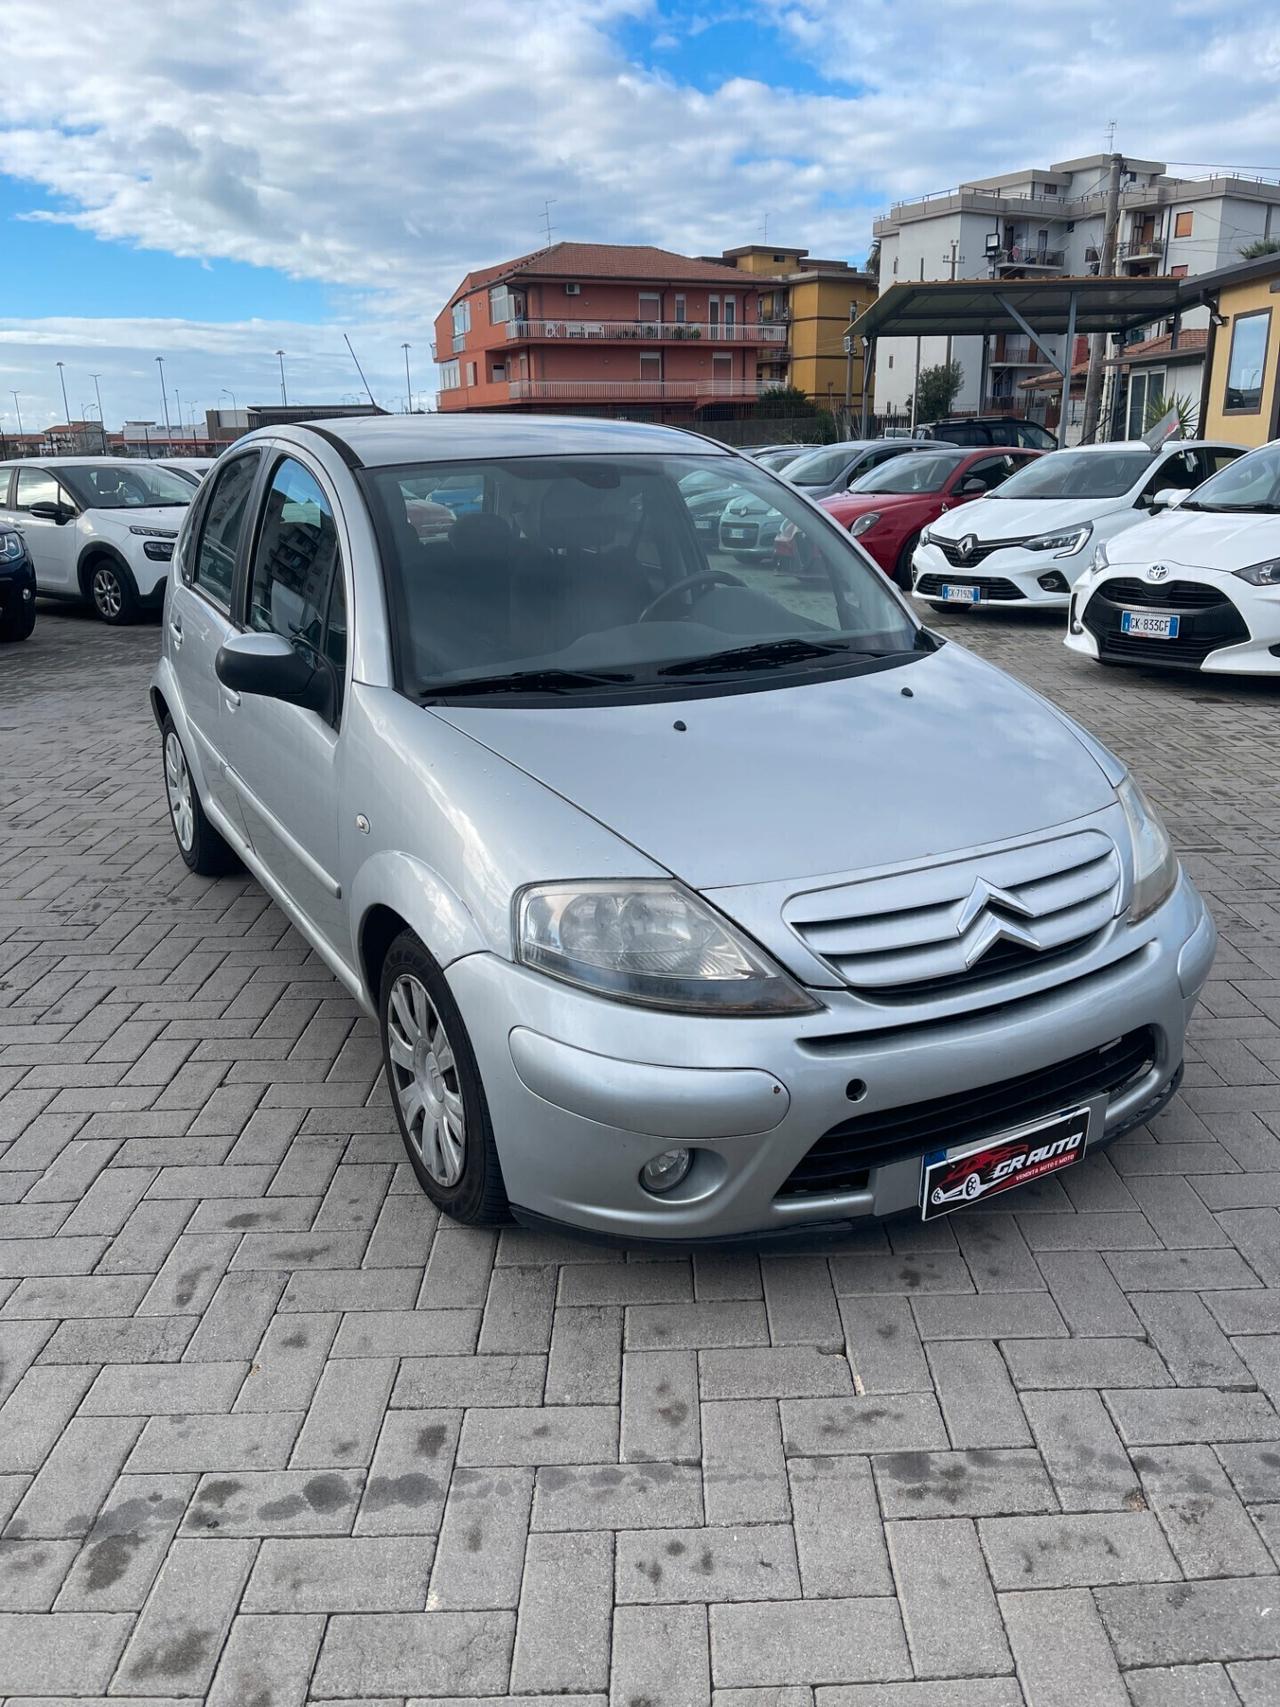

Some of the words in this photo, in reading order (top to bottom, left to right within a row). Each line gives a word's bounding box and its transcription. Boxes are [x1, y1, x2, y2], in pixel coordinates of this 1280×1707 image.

[993, 1154, 1027, 1179] GR
[1025, 1132, 1084, 1166] AUTO
[1016, 1168, 1039, 1181] VENDITA
[1039, 1162, 1054, 1172] AUTO
[1059, 1154, 1075, 1165] MOTO
